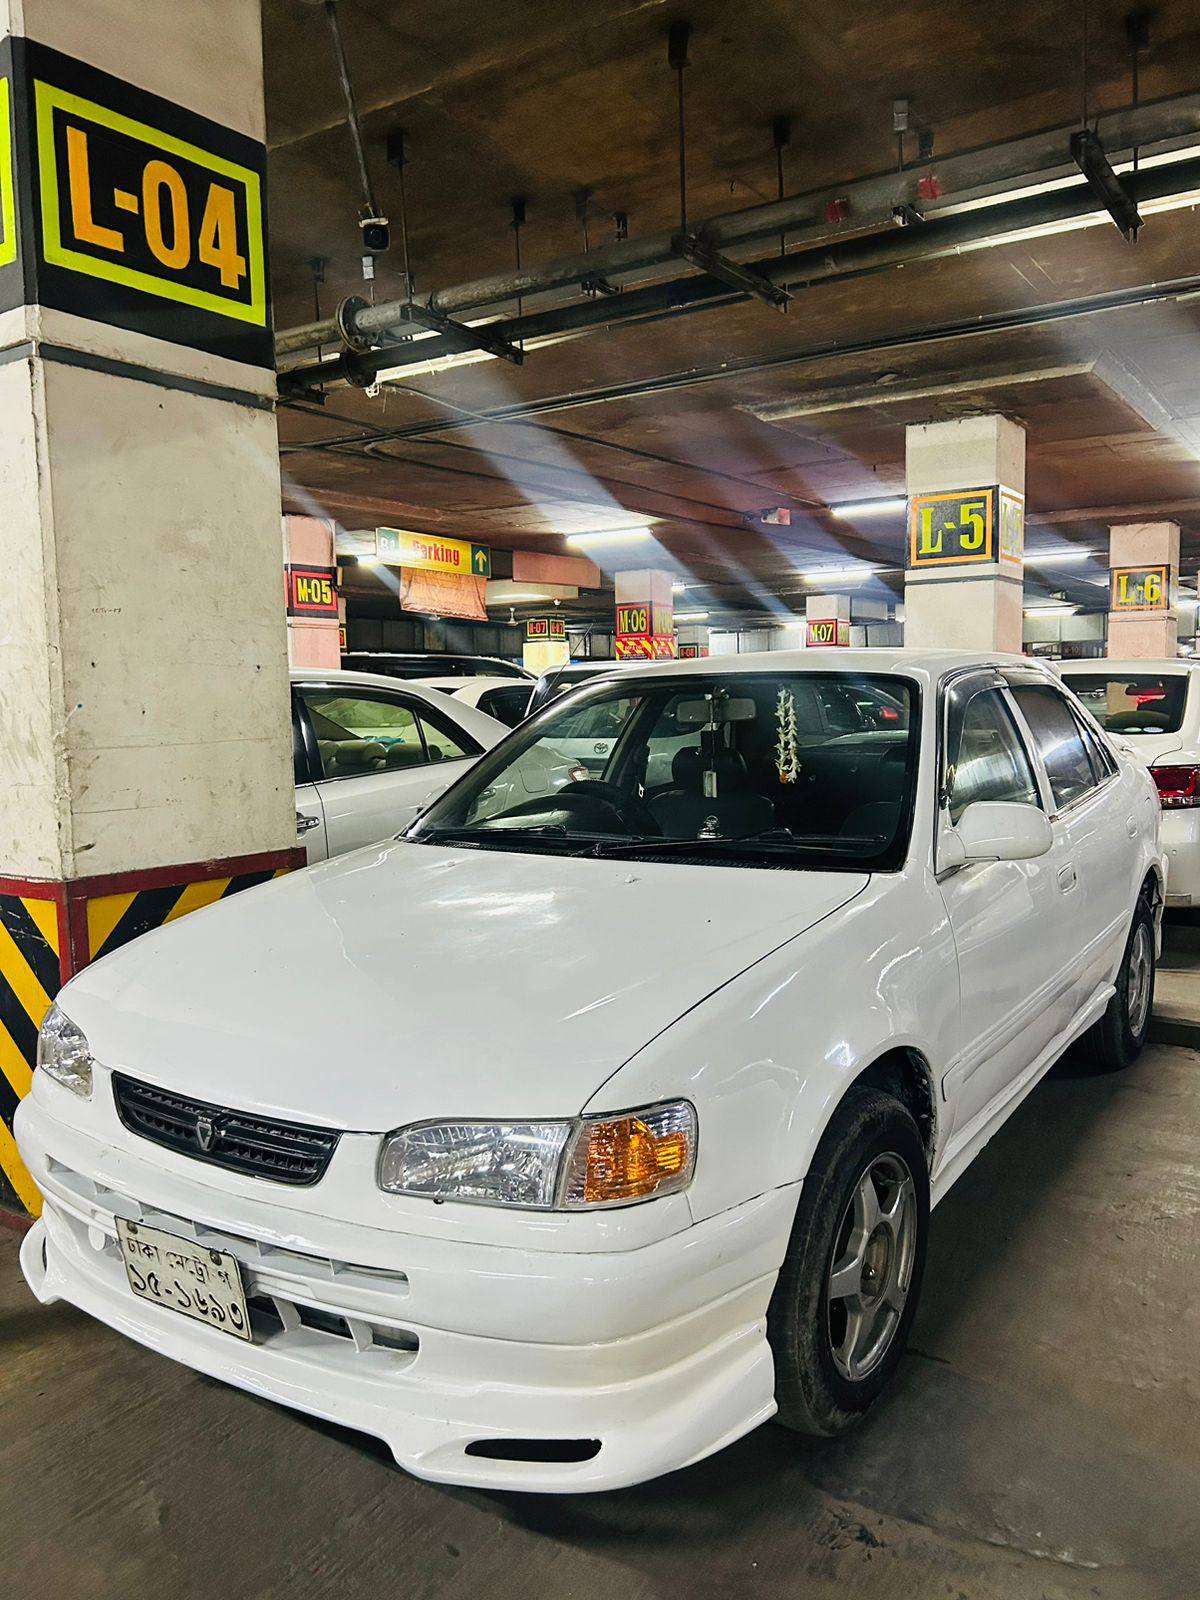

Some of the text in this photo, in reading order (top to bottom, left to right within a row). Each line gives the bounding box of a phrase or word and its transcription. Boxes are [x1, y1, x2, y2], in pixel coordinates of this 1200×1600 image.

[66, 125, 247, 290] L-04
[918, 502, 985, 555] L-5
[412, 540, 460, 566] Parking
[296, 577, 332, 604] M-05
[1119, 574, 1161, 604] L-6
[126, 1237, 162, 1262] ঢাকা
